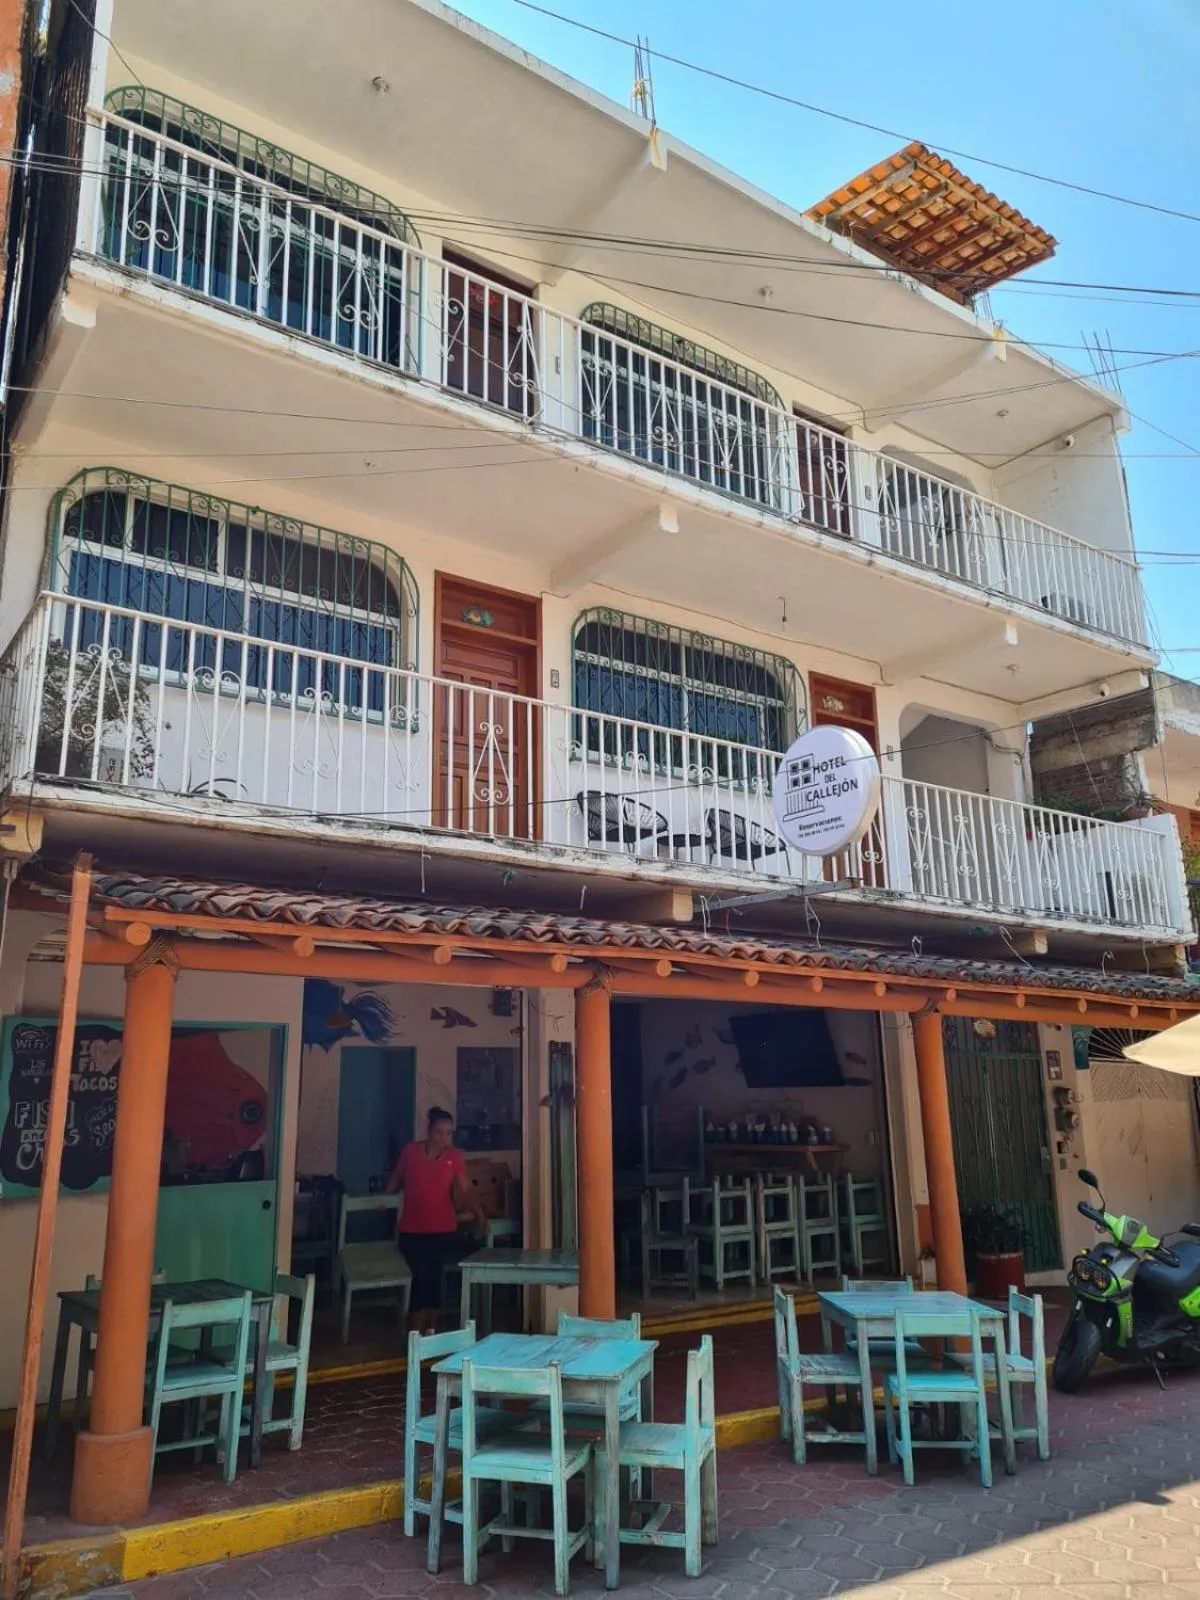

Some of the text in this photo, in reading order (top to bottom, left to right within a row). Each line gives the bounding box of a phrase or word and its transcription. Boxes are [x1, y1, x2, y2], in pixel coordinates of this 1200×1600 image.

[813, 756, 847, 774] HOTEL
[824, 773, 836, 783] DEL
[806, 778, 858, 802] CALLEJÓN
